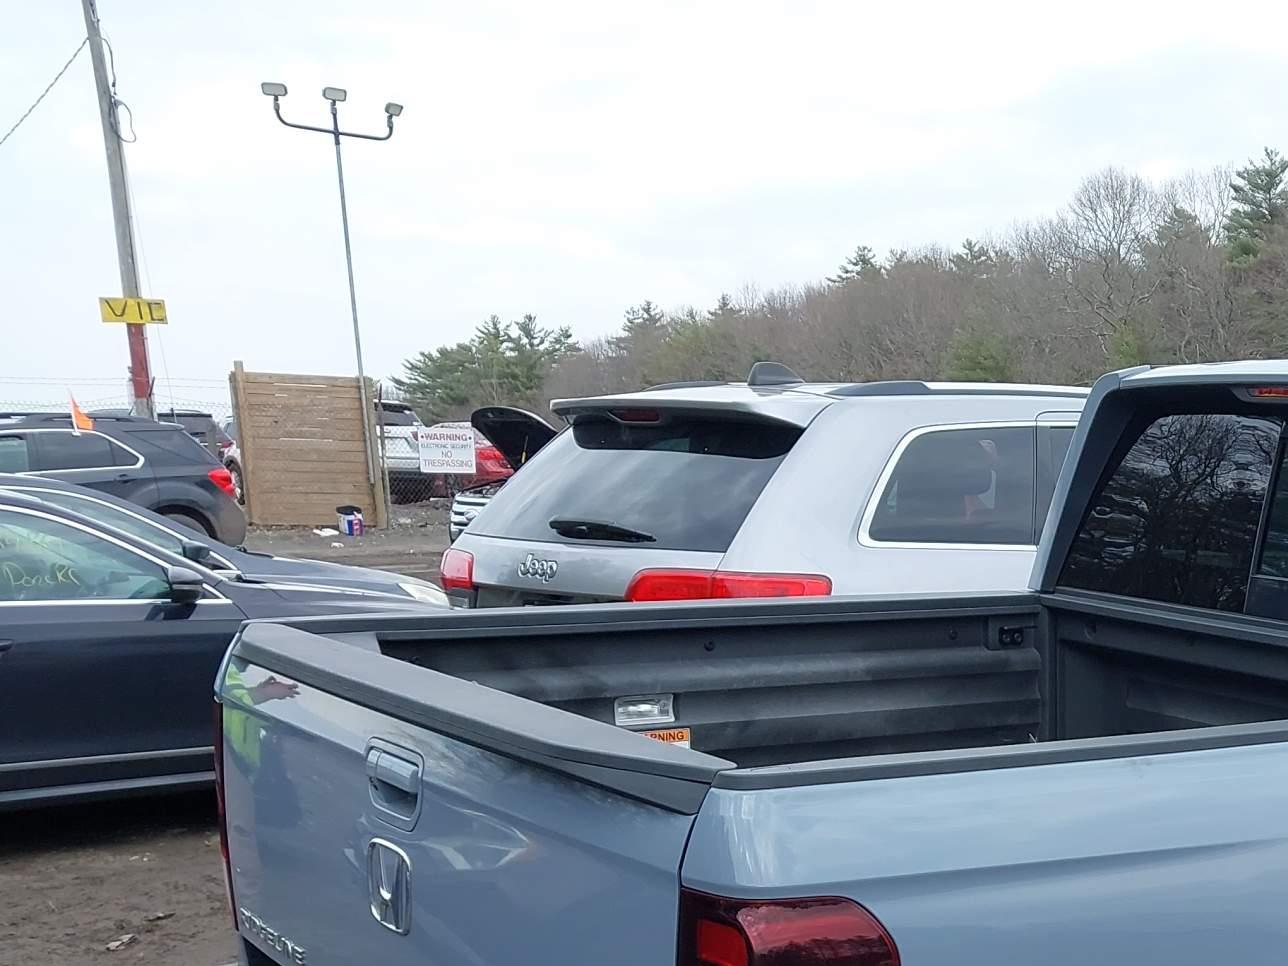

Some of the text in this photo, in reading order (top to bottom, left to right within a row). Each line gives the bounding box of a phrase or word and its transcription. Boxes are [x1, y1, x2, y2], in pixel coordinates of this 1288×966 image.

[424, 432, 468, 441] WARNING
[441, 450, 453, 458] NO
[423, 459, 473, 467] TRESPASSING
[518, 554, 558, 583] Jeep
